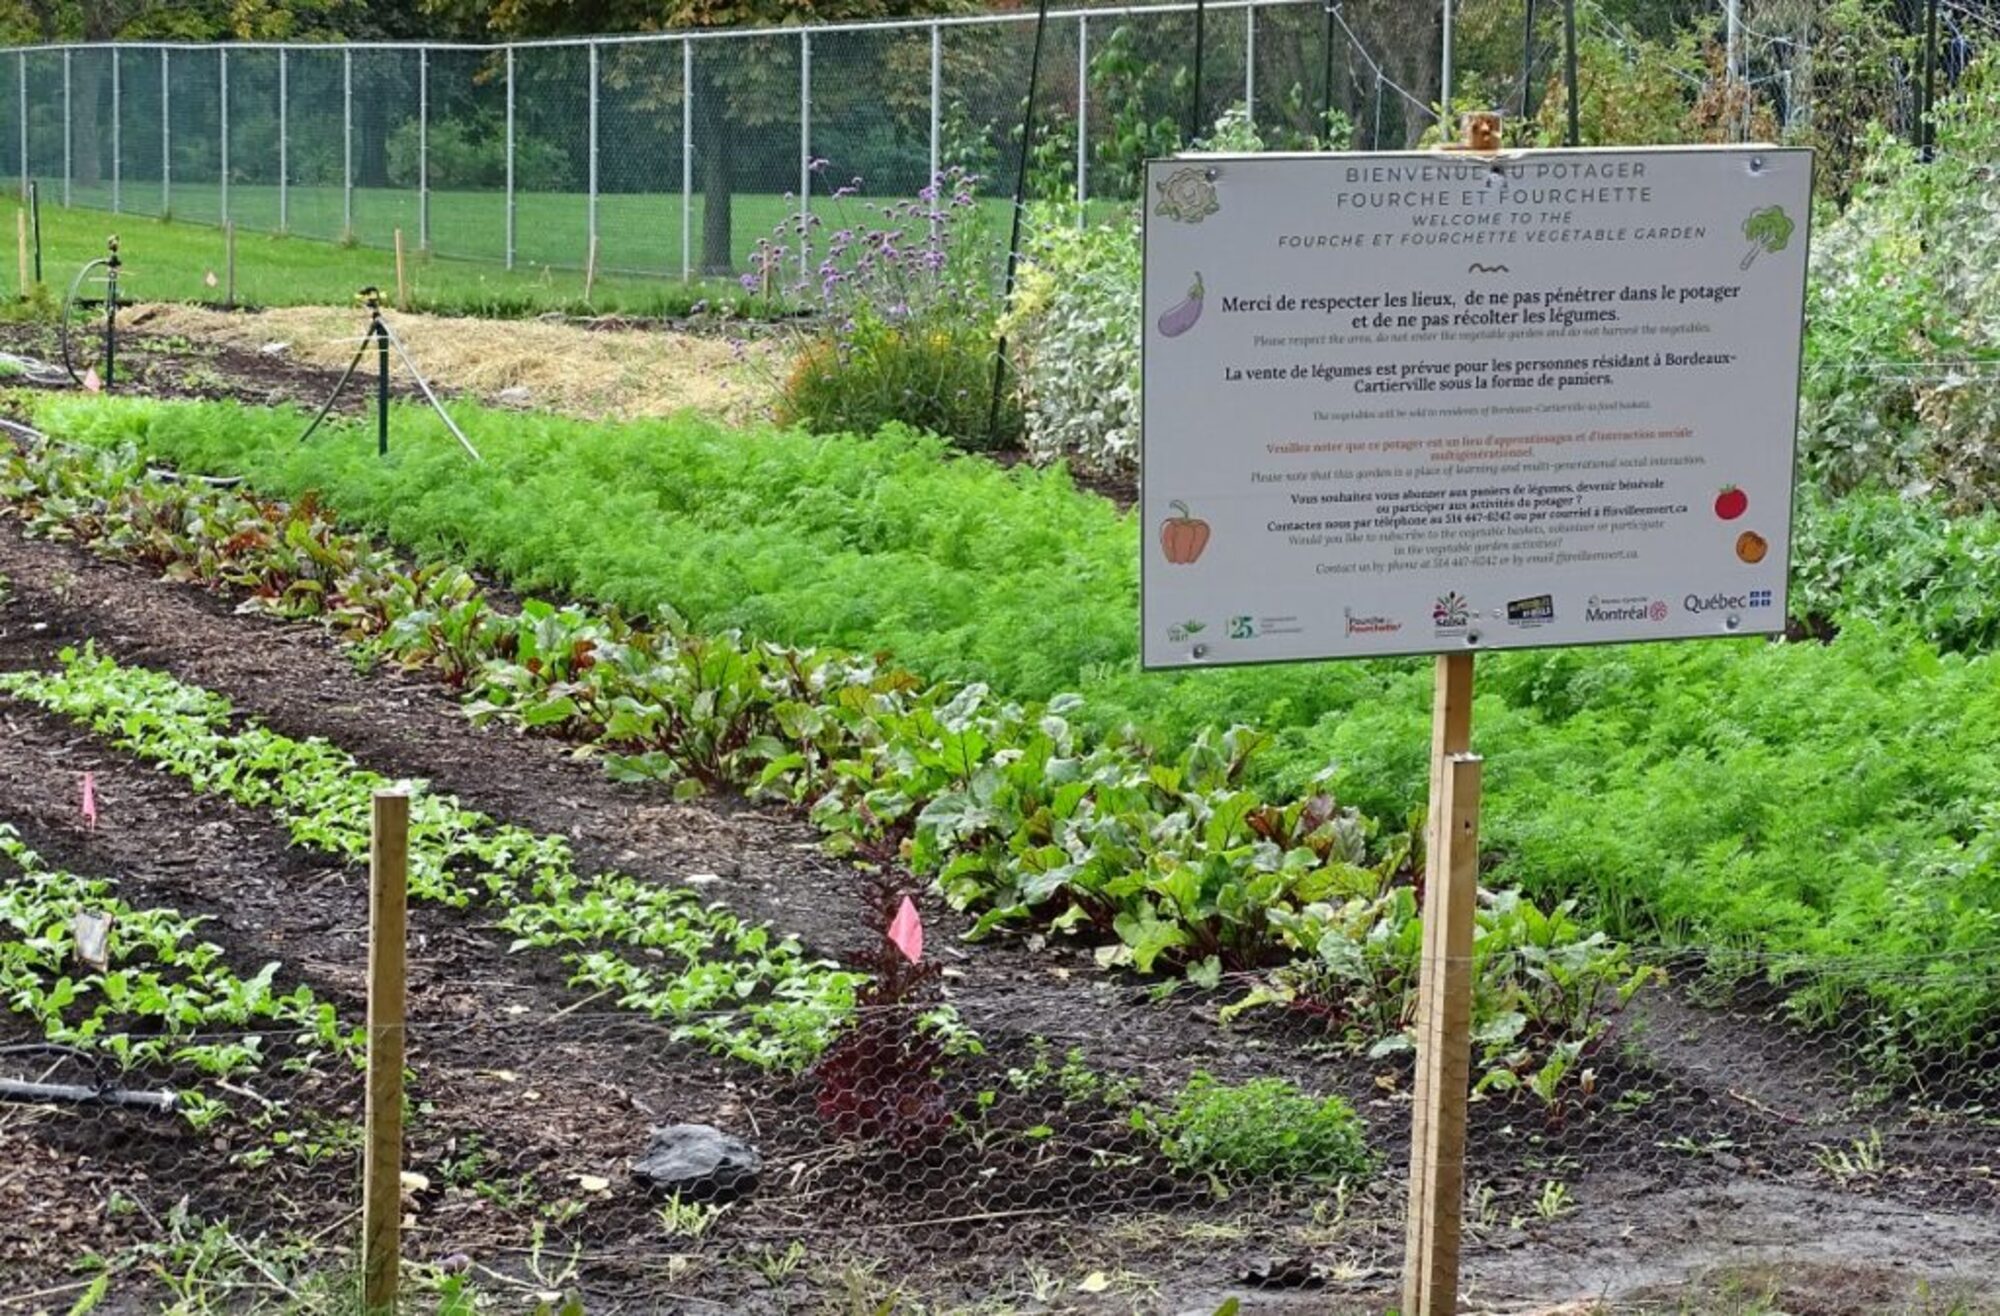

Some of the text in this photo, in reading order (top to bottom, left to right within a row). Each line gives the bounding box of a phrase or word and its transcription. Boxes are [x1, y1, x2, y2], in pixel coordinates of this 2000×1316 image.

[1346, 164, 1483, 183] BIENVENUE
[1536, 161, 1644, 179] POTAGER
[1337, 186, 1650, 208] FOURCHE ET FOURCHETTE
[1412, 211, 1571, 227] WELCOME TO THE
[1278, 226, 1705, 248] FOURCHE ET FOURCHETTE VEGETABLE GARDEN
[1222, 284, 1740, 314] Merci de respecter les lieux, de ne pas pénétrer dans le potager
[1351, 306, 1620, 330] et de ne pas récolter les légumes.
[1225, 350, 1736, 381] La vente de légumes est prévue pour les personnes résidant à Bordeaux-
[1353, 372, 1613, 393] Cartierville sous la forme de paniers.
[1290, 478, 1664, 504] Vous souhaitez vous abonner aux paniers de légumes, devenir bénévole
[1376, 494, 1582, 515] ou participer aux activités du potager ?
[1585, 604, 1647, 622] Montréal
[1683, 590, 1747, 614] Québec
[1231, 615, 1253, 639] 25
